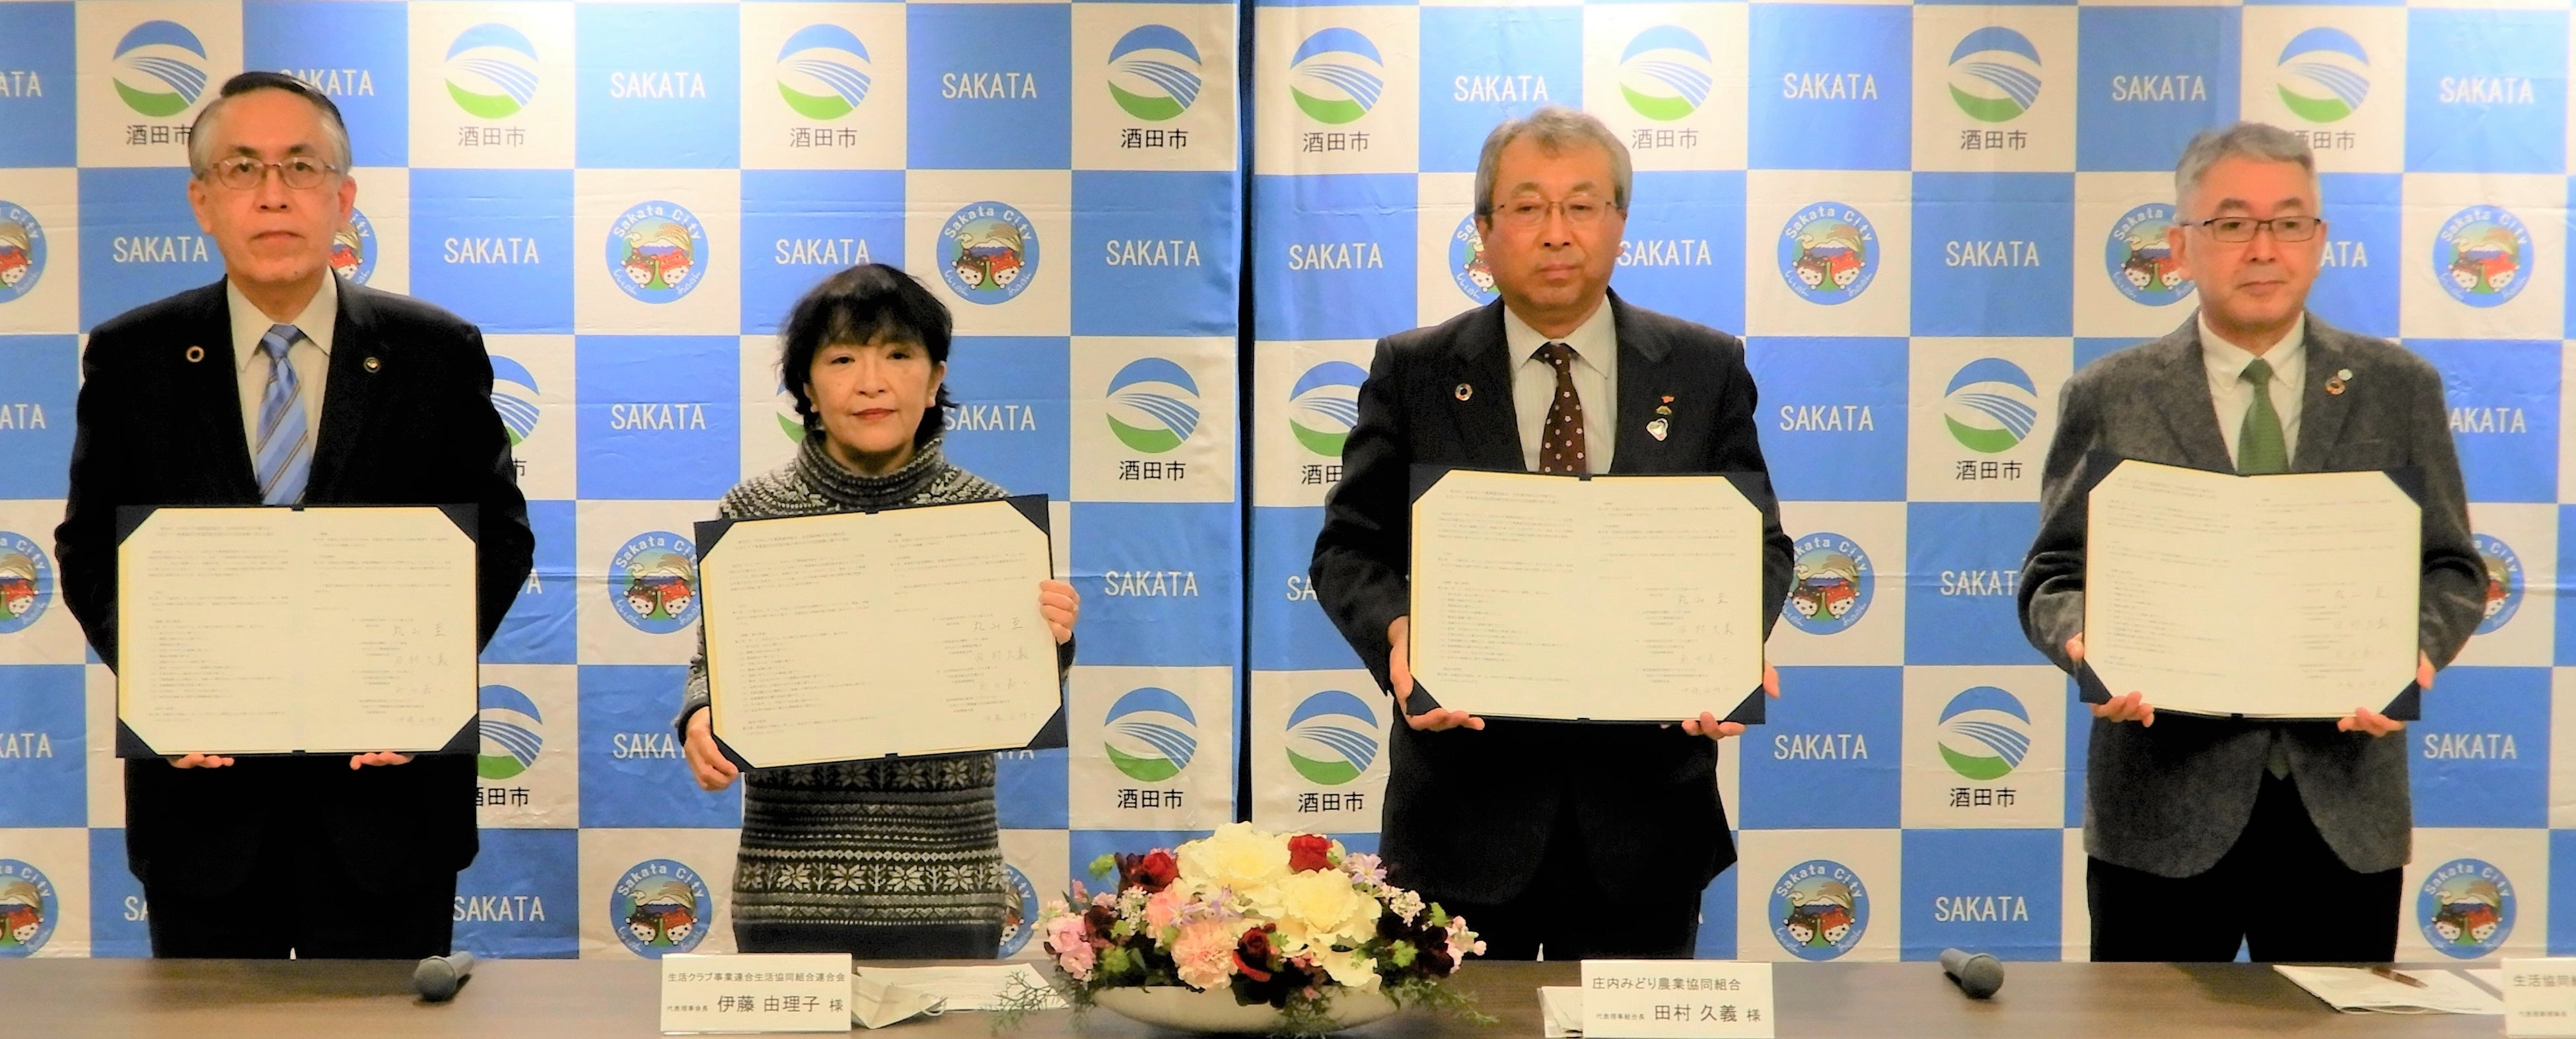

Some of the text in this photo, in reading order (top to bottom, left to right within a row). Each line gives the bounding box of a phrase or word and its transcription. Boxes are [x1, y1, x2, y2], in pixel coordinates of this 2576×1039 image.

[0, 71, 42, 98] ATA
[610, 71, 705, 98] SAKATA
[942, 73, 1036, 99] SAKATA
[1454, 75, 1548, 102] SAKATA
[1783, 73, 1877, 100] SAKATA
[2112, 75, 2206, 102] SAKATA
[2440, 77, 2534, 104] SAKATA
[126, 124, 192, 145] 酒田市
[458, 126, 526, 147] 酒田市
[790, 127, 858, 149] 酒田市
[1121, 128, 1188, 150] 酒田市
[1303, 131, 1370, 153] 酒田市
[1631, 128, 1699, 149] 酒田市
[1960, 129, 2028, 151] 酒田市
[613, 205, 701, 239] Sakata City
[945, 206, 1032, 239] Sakata City
[1785, 206, 1873, 241] Sakata City
[2114, 208, 2163, 240] Sakata
[114, 236, 209, 263] SAKATA
[445, 238, 539, 264] SAKATA
[775, 239, 869, 265] SAKATA
[1106, 240, 1200, 267] SAKATA
[1289, 243, 1383, 270] SAKATA
[1617, 240, 1711, 266] SAKATA
[1946, 241, 2039, 267] SAKATA
[2320, 241, 2367, 268] ATA
[0, 404, 46, 429] ATA
[611, 404, 705, 430] SAKATA
[943, 405, 1036, 431] SAKATA
[1780, 406, 1874, 431] SAKATA
[2449, 407, 2526, 434] AKATA
[1119, 460, 1186, 482] 酒田市
[1301, 464, 1343, 485] 酒田
[1956, 460, 2022, 481] 酒田市
[15, 540, 46, 569] City
[615, 536, 665, 568] Sakata
[1839, 541, 1867, 571] City
[1105, 571, 1198, 597] SAKATA
[1940, 571, 2018, 596] SAKAT
[613, 733, 686, 759] SAKA
[1774, 734, 1868, 760] SAKATA
[2423, 734, 2517, 760] SAKATA
[1118, 789, 1184, 808] 酒田市
[1298, 791, 1365, 813] 酒田市
[1950, 787, 2017, 808] 酒田市
[21, 867, 51, 897] City
[618, 863, 704, 898] Sakata City
[1776, 864, 1863, 898] Sakata City
[2425, 863, 2474, 895] Sakata
[453, 896, 545, 922] SAKATA
[1935, 896, 2028, 922] SAKATA
[1592, 977, 1741, 991] 庄内みどり農業協同組合
[717, 995, 755, 1013] 伊藤
[764, 995, 820, 1013] 由理子
[829, 998, 844, 1013] 様
[1655, 1003, 1691, 1022] 田村
[1700, 1003, 1738, 1022] 久義
[1746, 1007, 1762, 1022] 様
